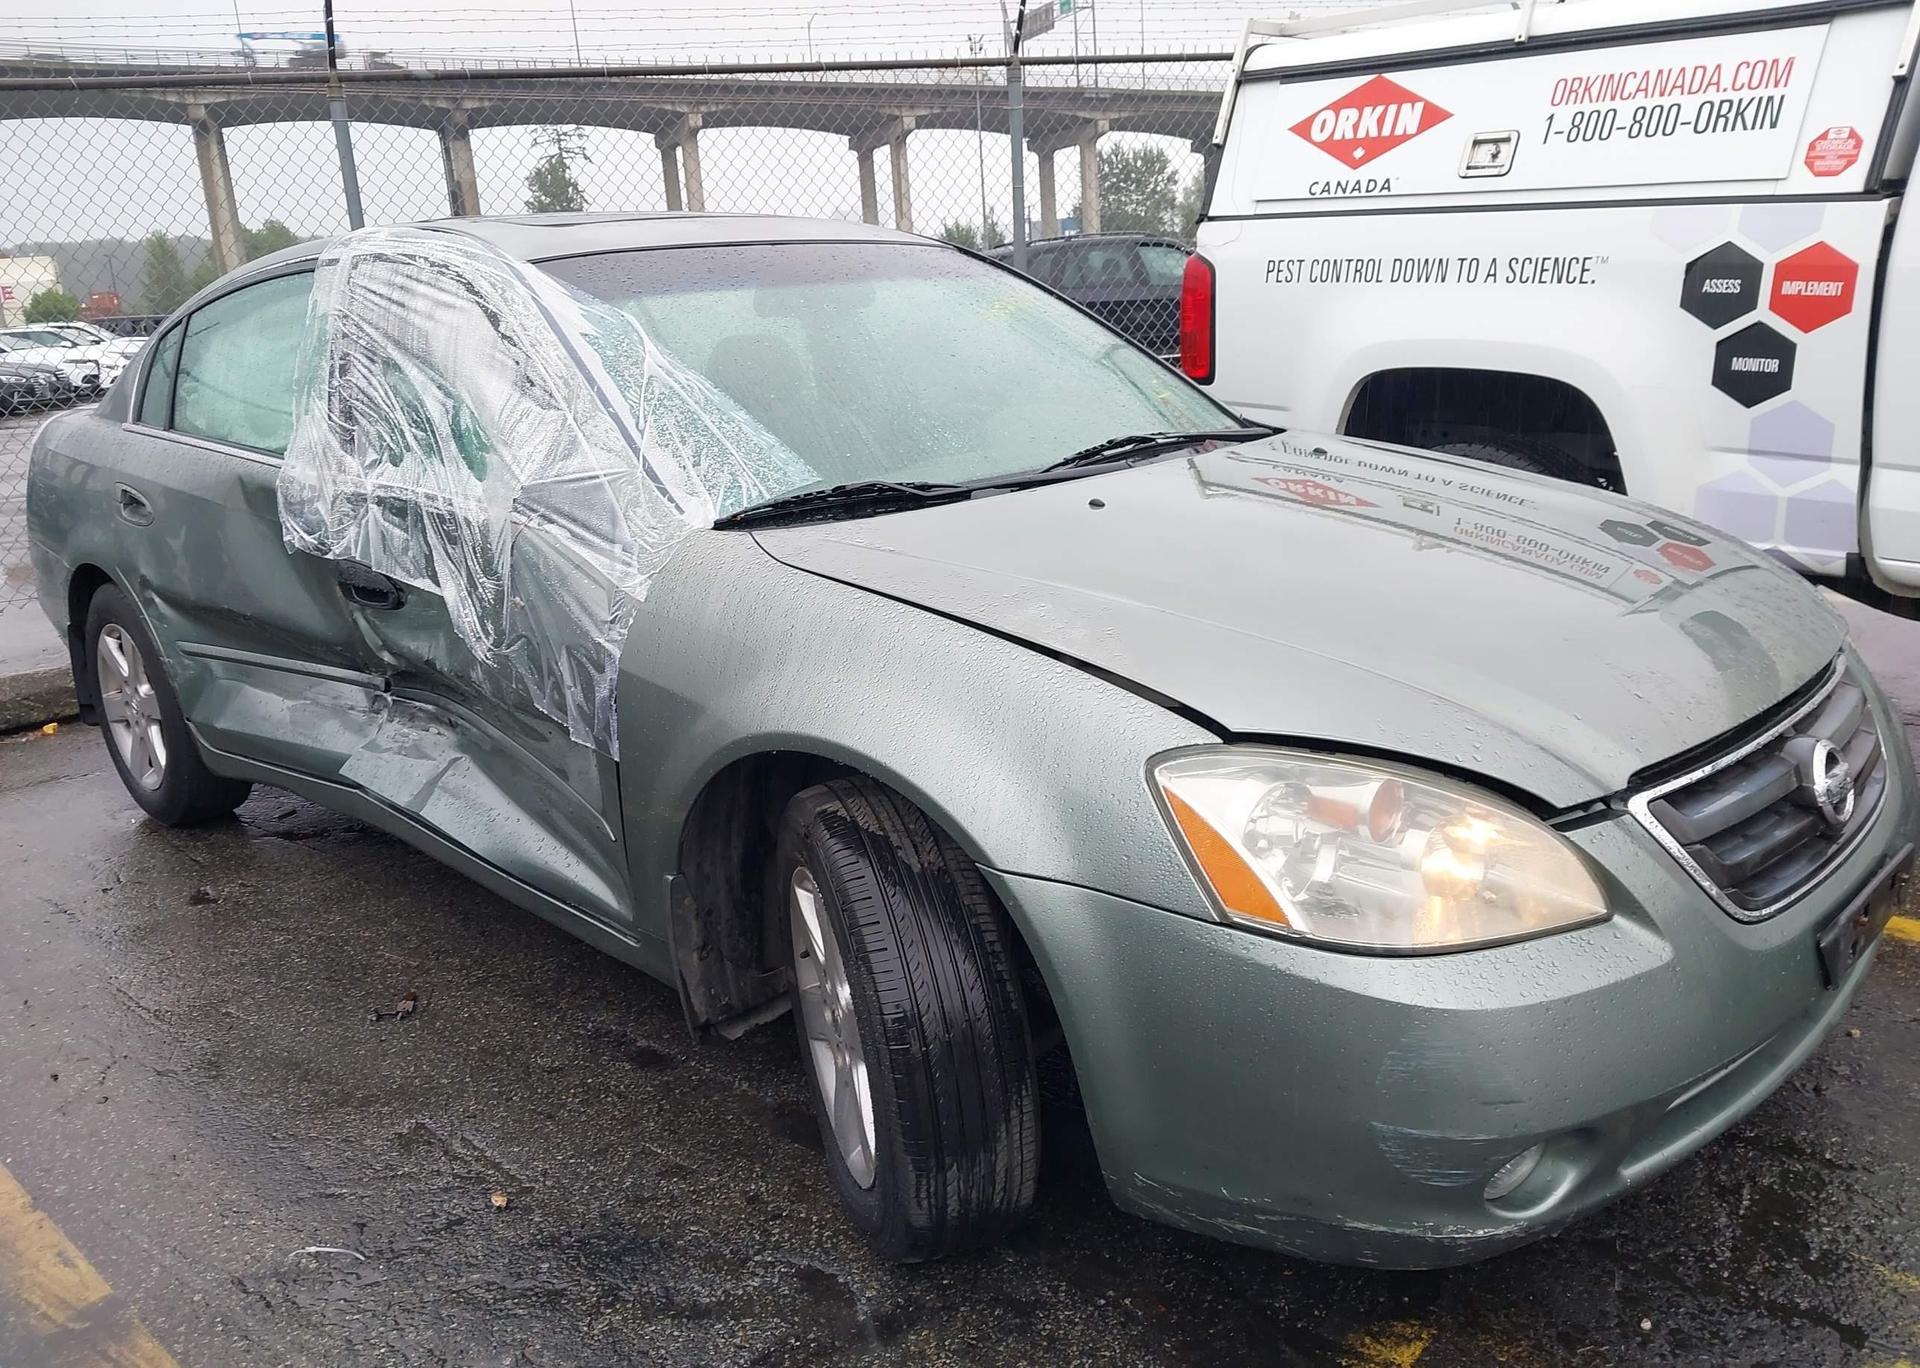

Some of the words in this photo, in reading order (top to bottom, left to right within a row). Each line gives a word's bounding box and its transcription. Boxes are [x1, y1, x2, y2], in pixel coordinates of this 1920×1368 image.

[1550, 56, 1796, 108] ORKINCANADA.COM
[1310, 101, 1425, 143] ORKIN
[1542, 94, 1786, 145] 1-800-800-ORKIN
[1308, 178, 1391, 197] CANADA
[1265, 258, 1304, 284] PEST
[1309, 258, 1384, 284] CONTROL
[1390, 258, 1450, 284] DOWN
[1456, 257, 1481, 284] TO
[1484, 257, 1498, 284] A
[1702, 278, 1742, 294] ASSESS
[1781, 280, 1845, 297] IMPLEMENT
[1731, 357, 1780, 374] MONITOR
